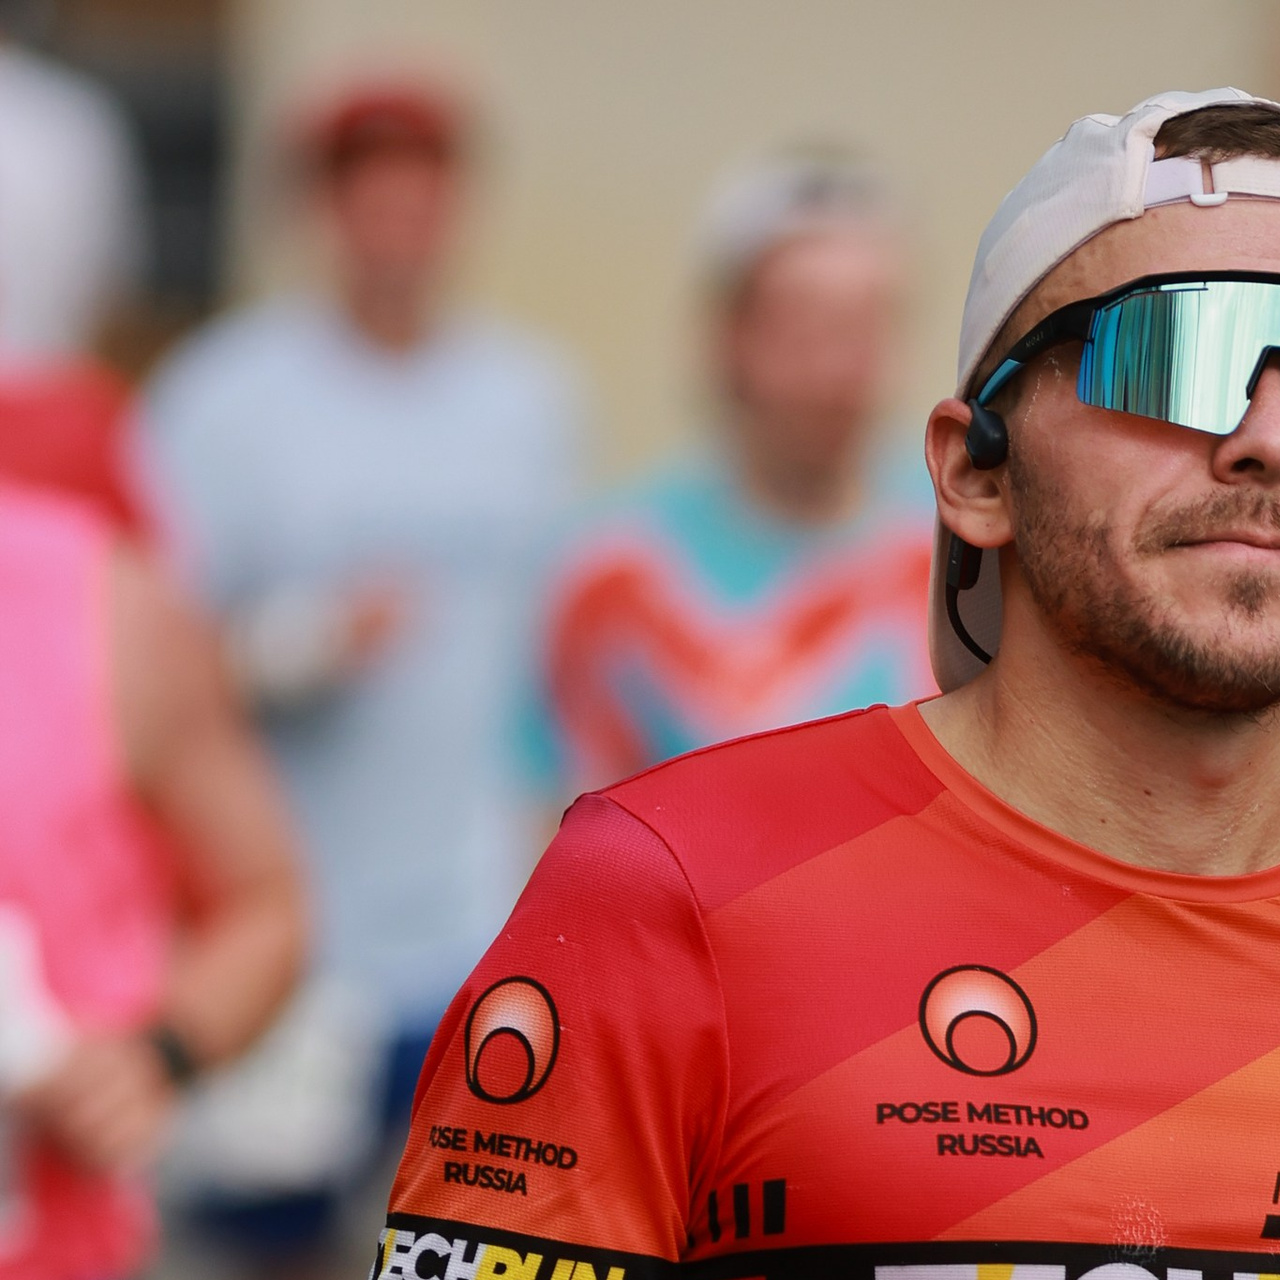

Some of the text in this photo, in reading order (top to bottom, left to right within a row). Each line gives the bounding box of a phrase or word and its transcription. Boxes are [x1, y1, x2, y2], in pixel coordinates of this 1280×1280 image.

[876, 1101, 1089, 1130] POSE METHOD
[473, 1130, 578, 1170] METHOD
[937, 1134, 1045, 1159] RUSSIA
[444, 1161, 527, 1196] RUSSIA
